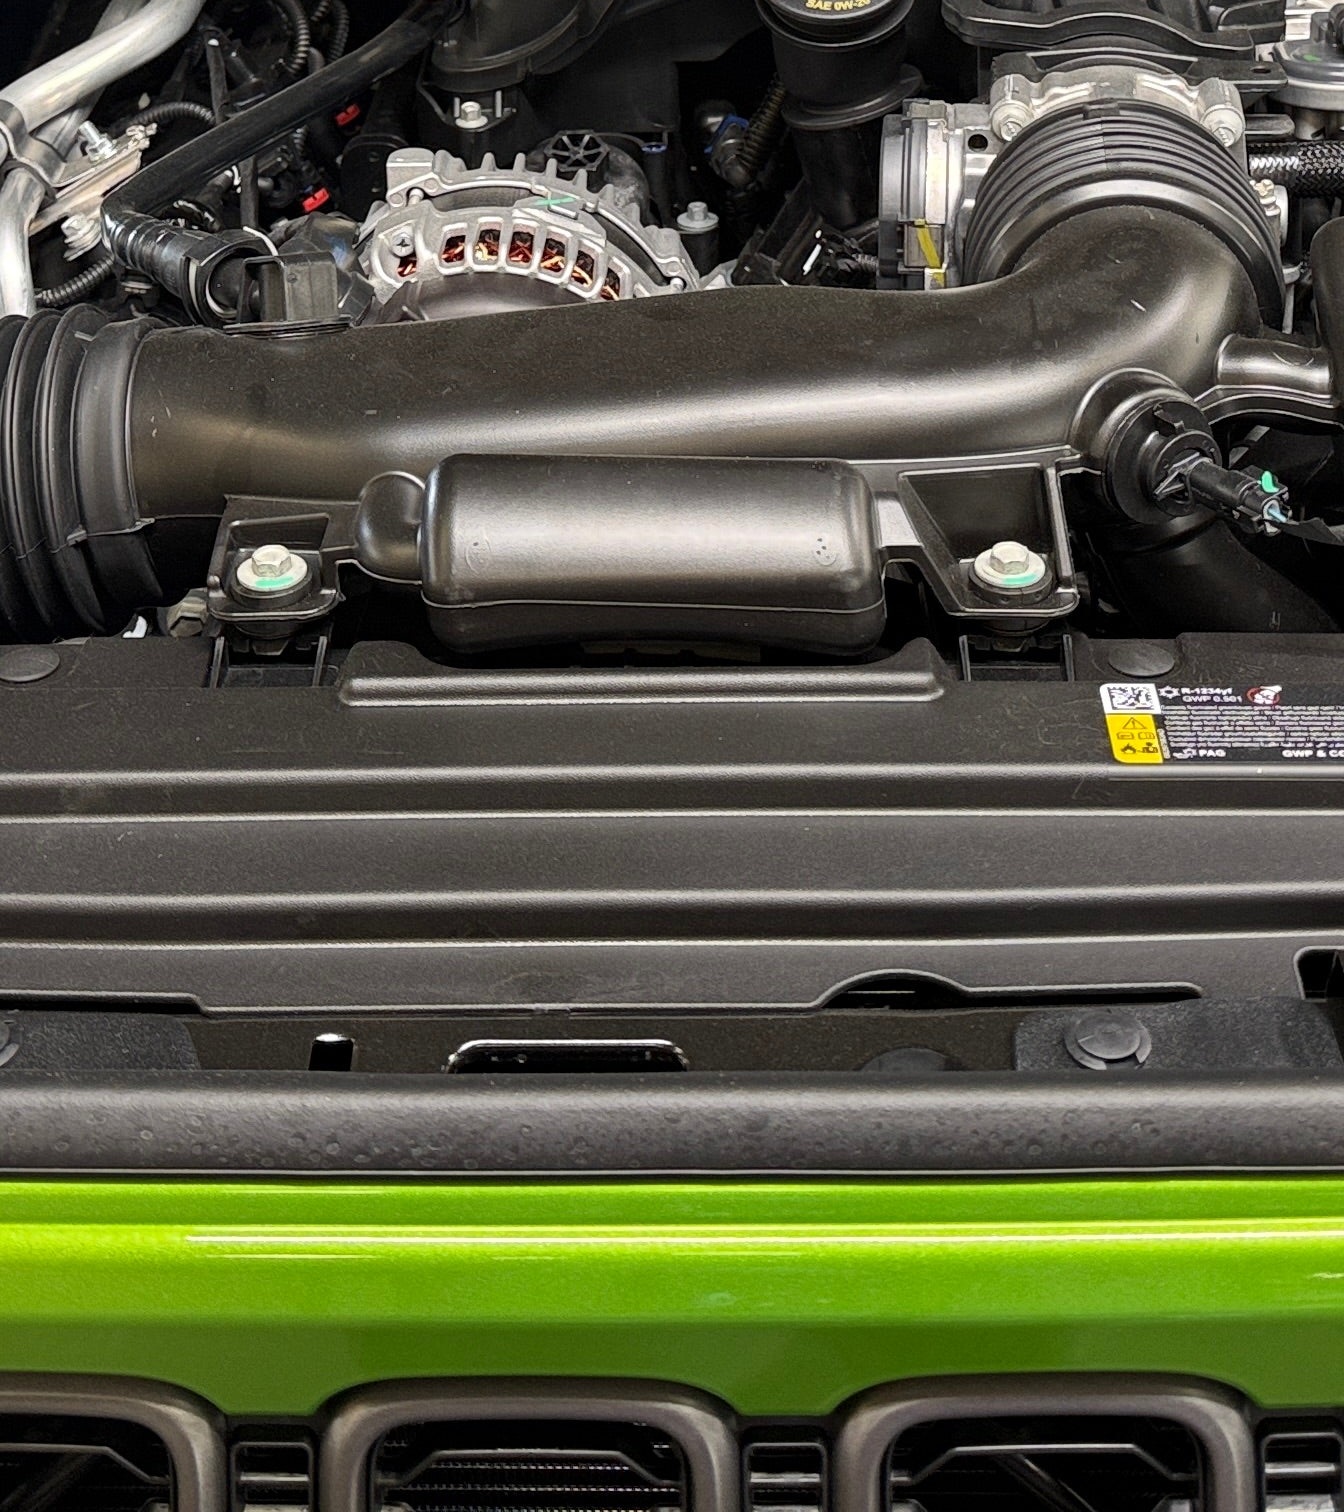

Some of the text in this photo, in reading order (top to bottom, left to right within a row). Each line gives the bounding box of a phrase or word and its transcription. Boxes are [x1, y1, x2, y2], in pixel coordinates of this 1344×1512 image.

[1180, 688, 1233, 696] R-1234yf
[1182, 695, 1212, 703] GWP
[1198, 749, 1226, 757] PAG
[1282, 749, 1313, 757] GWP
[1316, 749, 1327, 757] &
